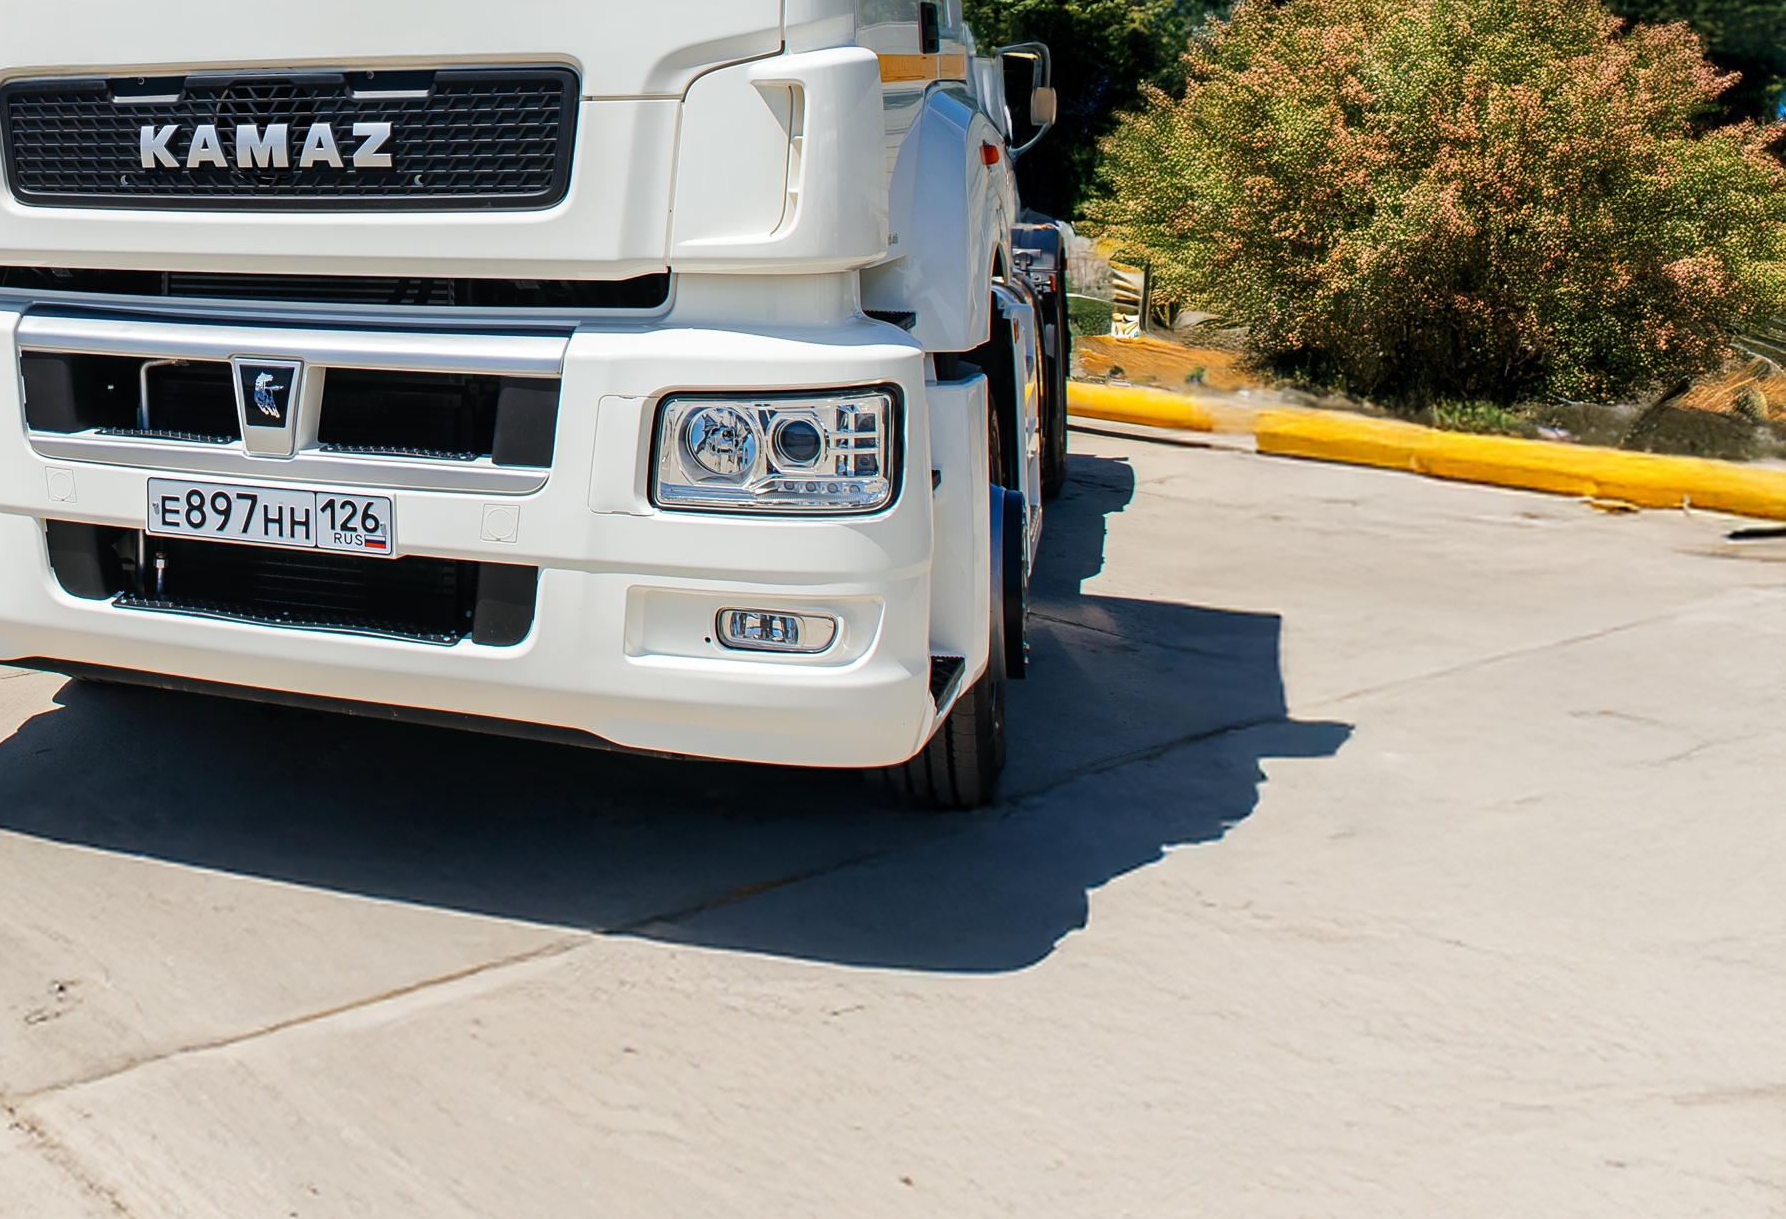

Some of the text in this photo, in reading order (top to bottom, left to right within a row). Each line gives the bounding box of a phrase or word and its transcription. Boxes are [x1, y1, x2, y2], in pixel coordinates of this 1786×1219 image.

[140, 121, 394, 169] KAMAZ
[319, 497, 381, 533] 126
[333, 532, 364, 546] RUS
